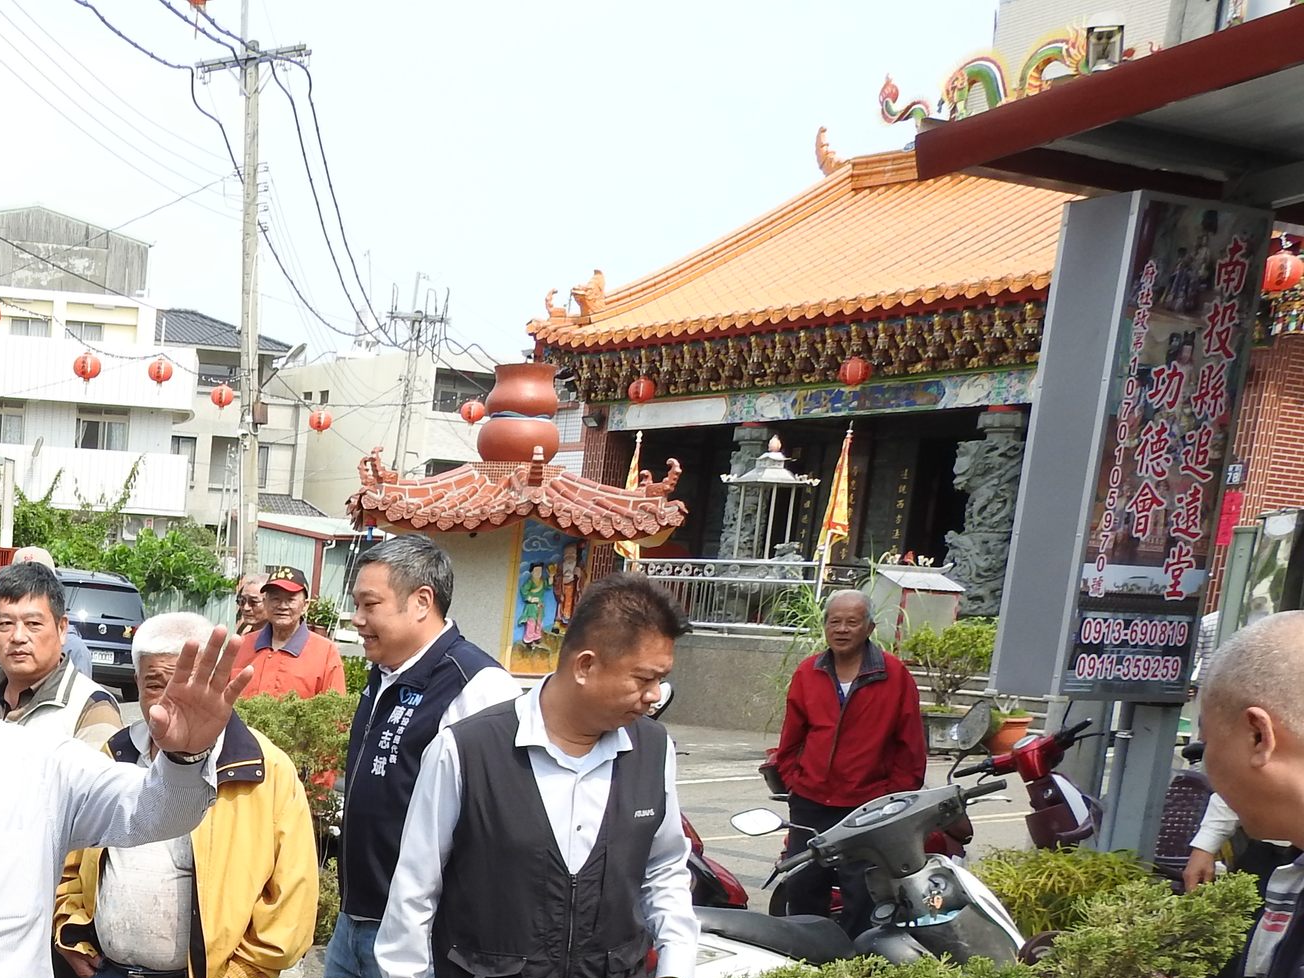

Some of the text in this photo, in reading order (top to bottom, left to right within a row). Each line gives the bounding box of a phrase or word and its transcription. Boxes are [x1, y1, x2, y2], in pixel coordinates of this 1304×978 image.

[1126, 360, 1185, 543] 功德會
[1162, 234, 1248, 600] 南投縣追遠堂
[1075, 654, 1181, 681] 0911-359259
[1081, 618, 1188, 646] 0913-690819
